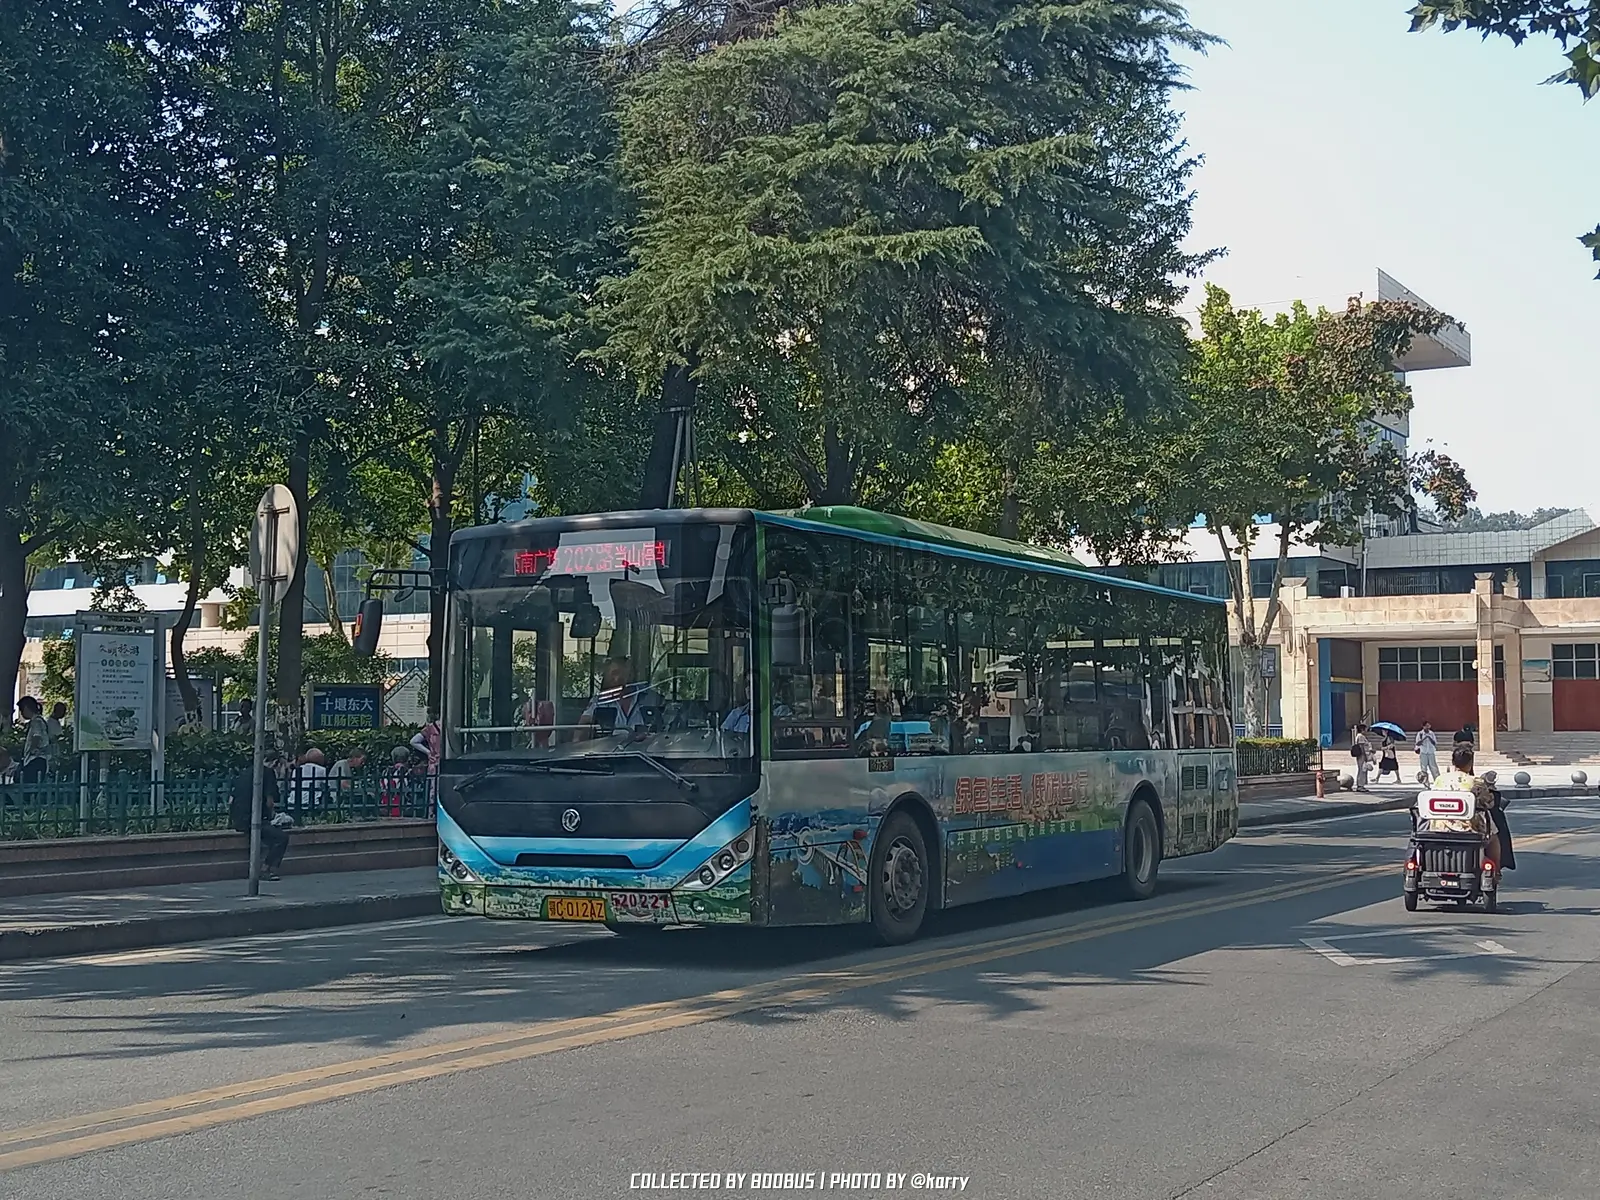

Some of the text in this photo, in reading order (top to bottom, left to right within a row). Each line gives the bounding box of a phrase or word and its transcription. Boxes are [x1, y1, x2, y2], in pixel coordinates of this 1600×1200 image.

[99, 641, 140, 658] 文明旅游
[320, 697, 374, 711] 十堰东大
[320, 713, 373, 727] 肛肠医院
[954, 769, 1090, 814] 绿色生活 低碳出行
